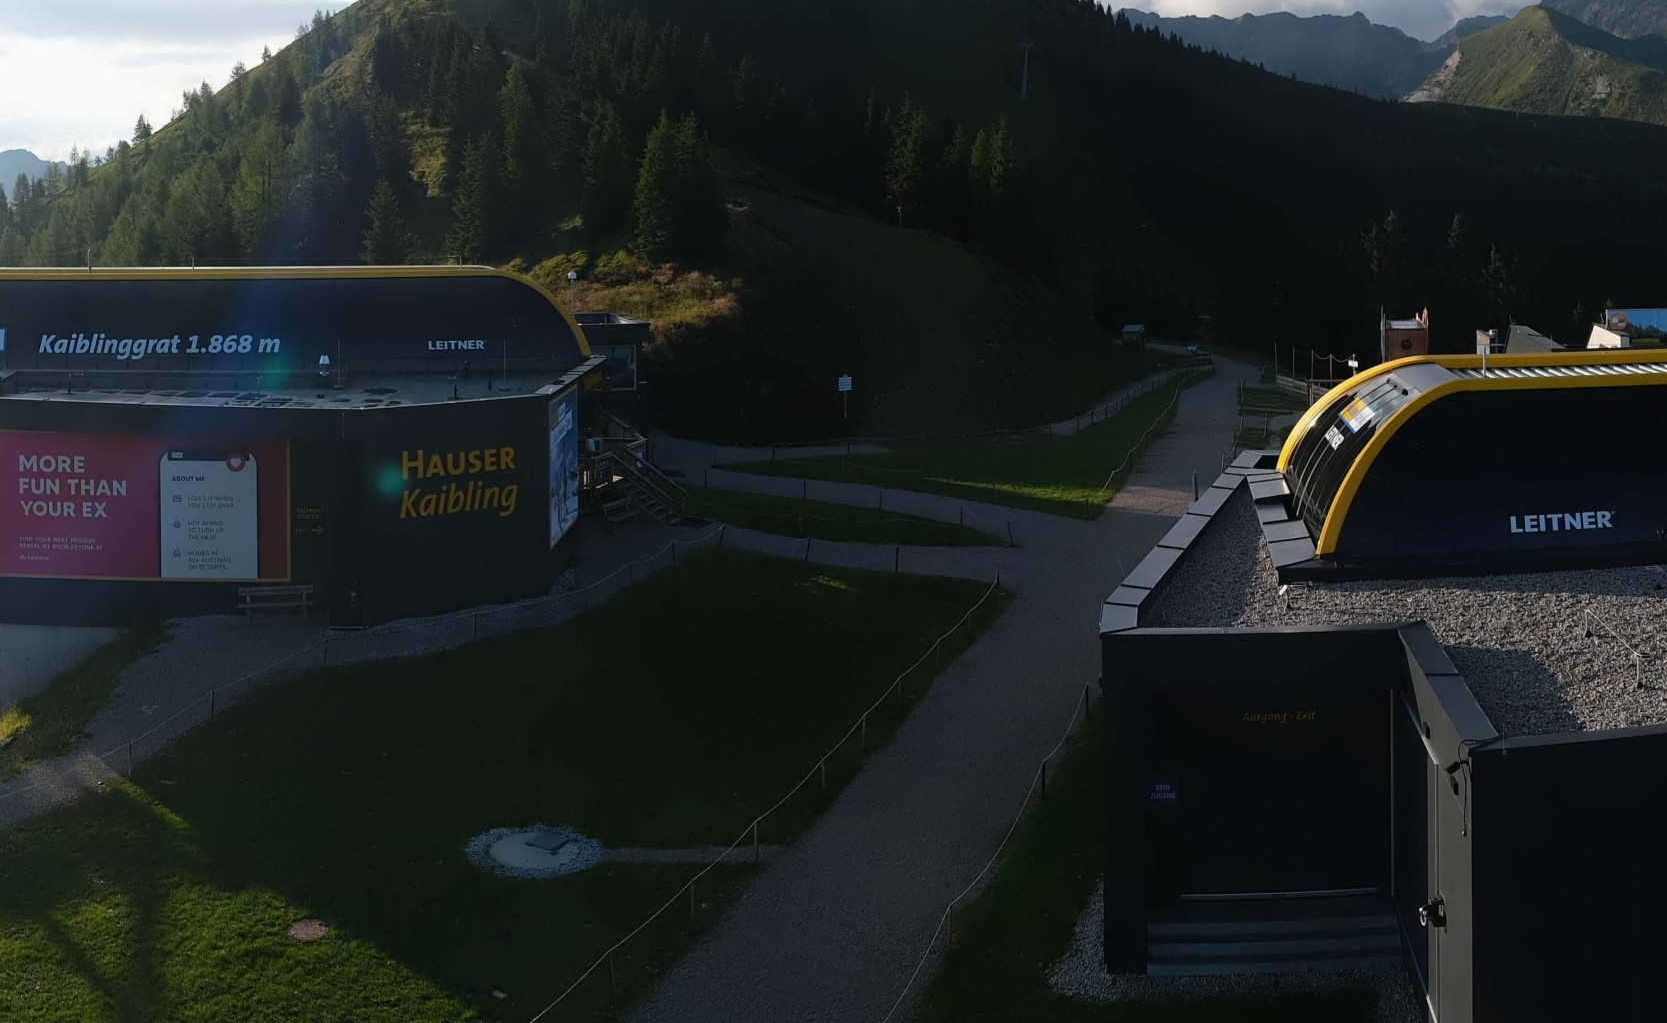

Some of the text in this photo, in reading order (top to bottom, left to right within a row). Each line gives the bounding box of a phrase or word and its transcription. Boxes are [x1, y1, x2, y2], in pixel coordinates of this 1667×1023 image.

[38, 333, 280, 360] Kaiblinggrat 1.868 m
[428, 340, 485, 351] LEITNER
[19, 454, 85, 473] MORE
[401, 446, 516, 481] HAUSER
[19, 478, 127, 496] FUN THAN
[20, 500, 107, 518] YOUR EX
[400, 480, 518, 519] Kaibling
[1509, 510, 1614, 533] LEITNER
[1241, 712, 1287, 724] Ausgang
[1296, 709, 1316, 720] Exit
